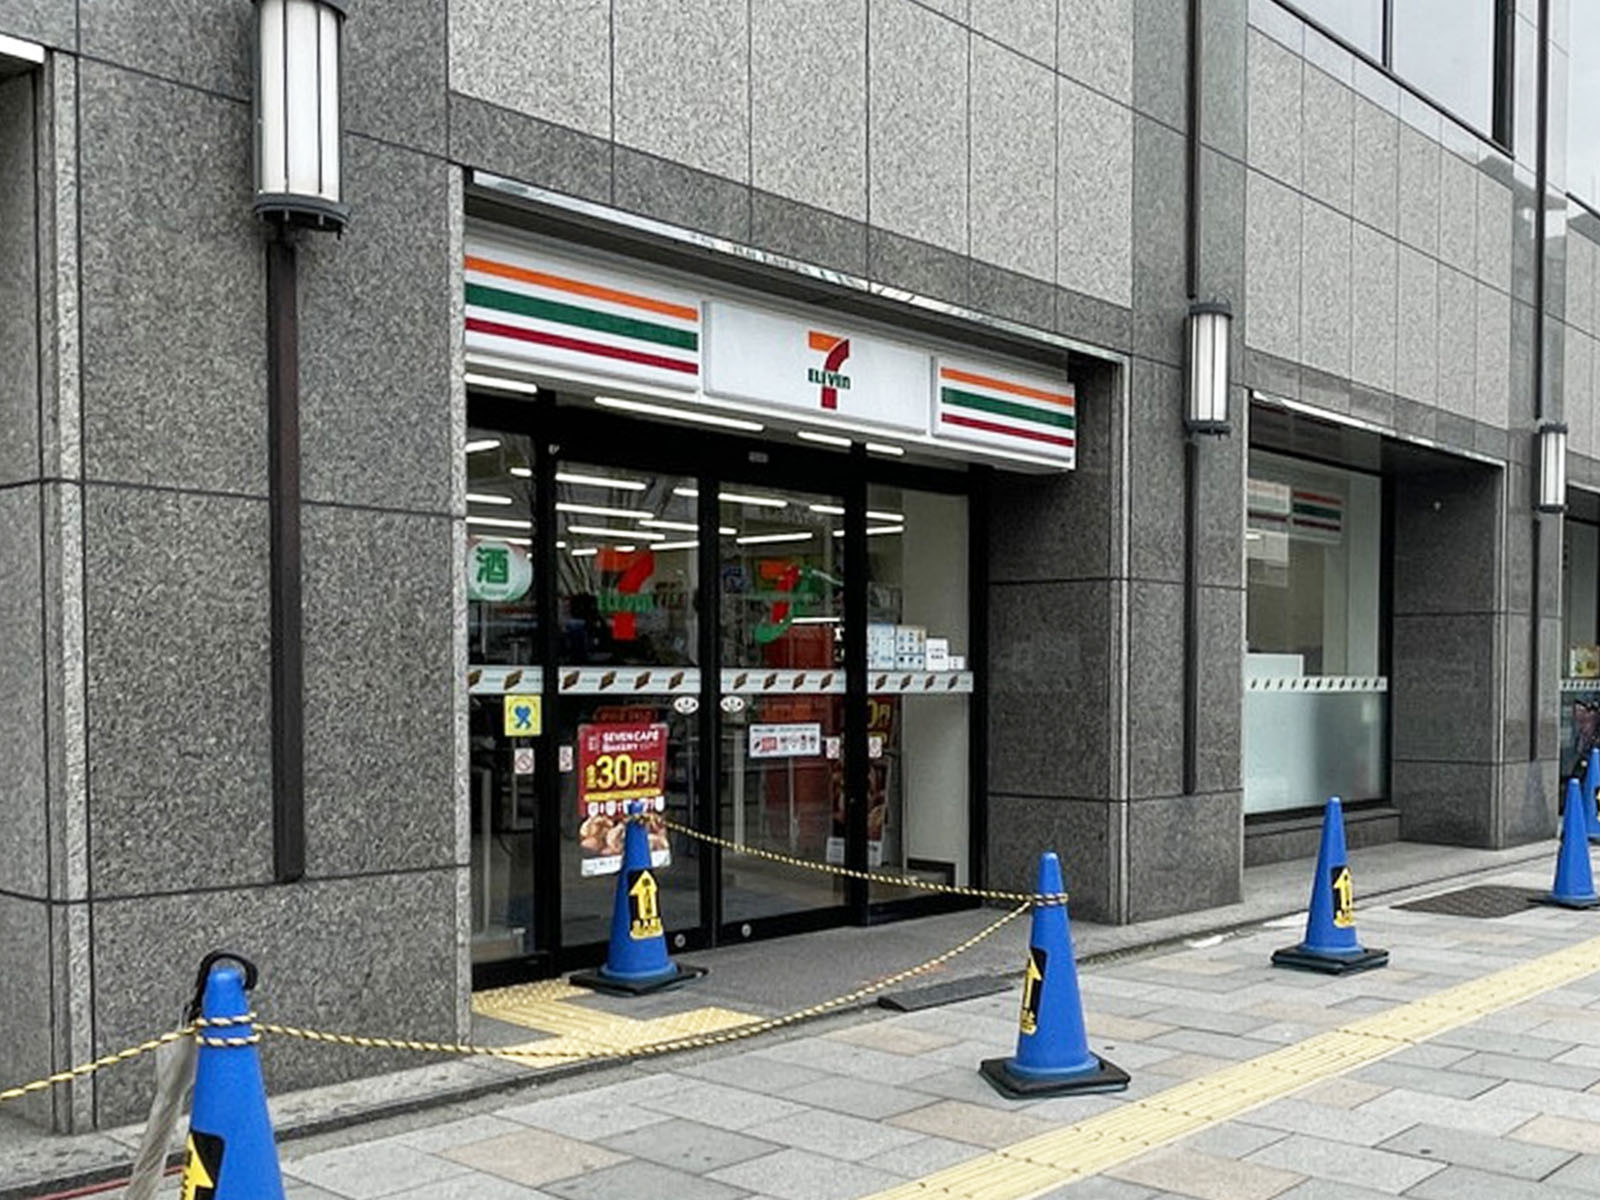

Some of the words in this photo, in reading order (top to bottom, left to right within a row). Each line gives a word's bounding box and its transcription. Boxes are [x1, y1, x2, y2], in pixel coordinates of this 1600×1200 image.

[808, 331, 849, 410] 7
[477, 547, 508, 583] 酒
[596, 549, 655, 638] 7
